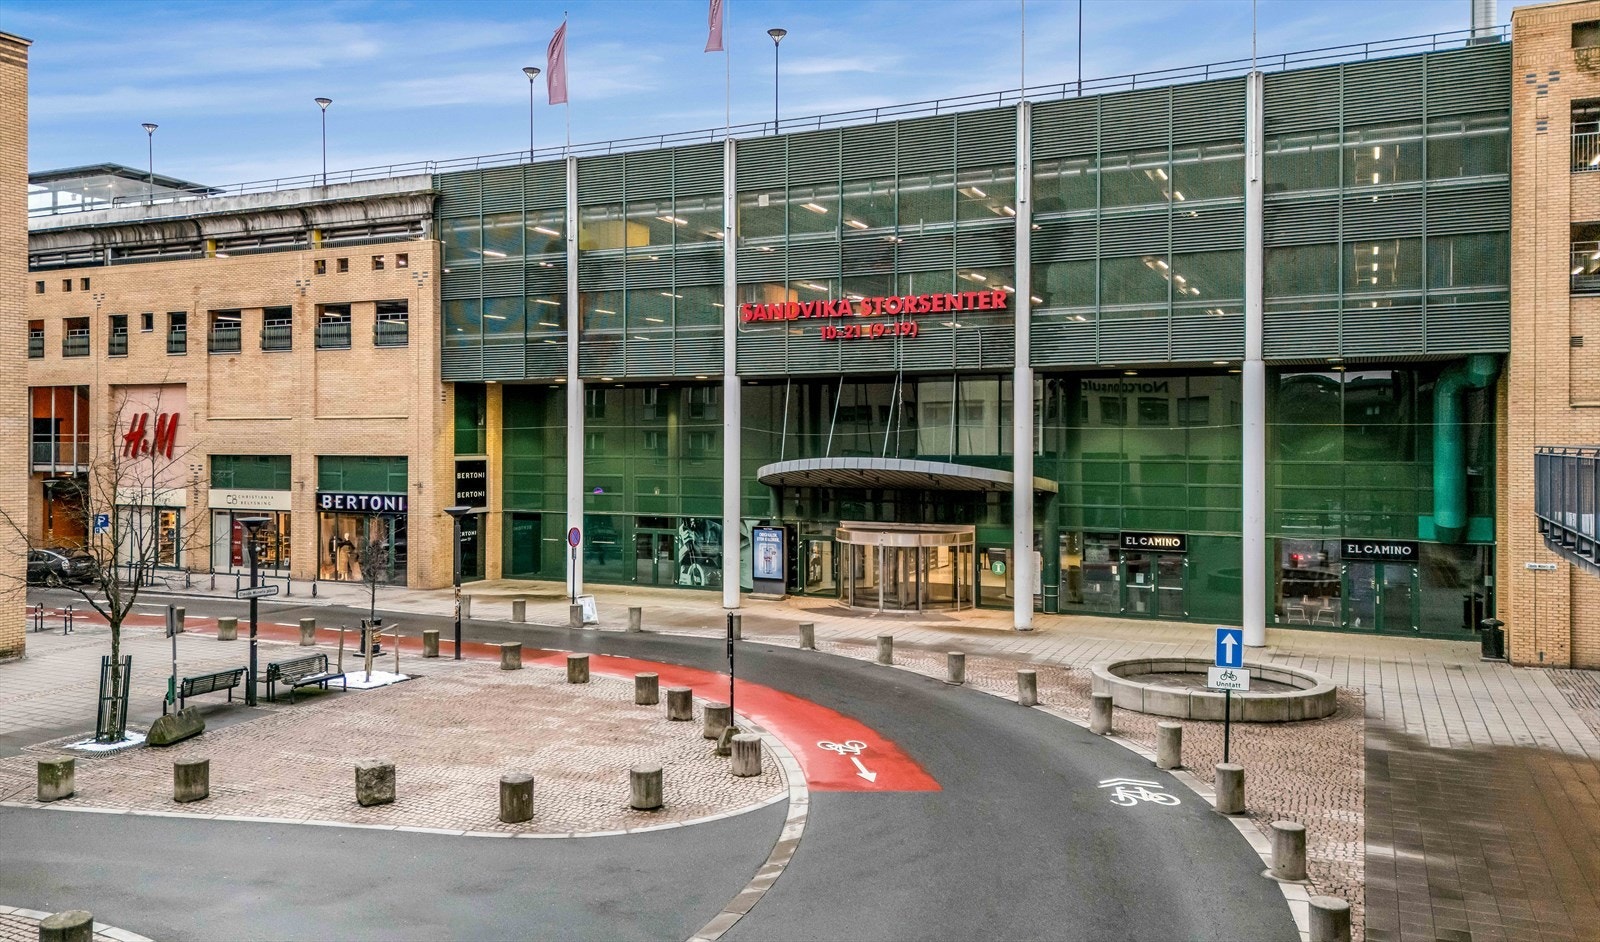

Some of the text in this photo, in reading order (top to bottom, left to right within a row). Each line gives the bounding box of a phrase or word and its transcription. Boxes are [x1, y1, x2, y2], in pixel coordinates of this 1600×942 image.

[742, 289, 1008, 323] SANDVIKA STORSENTER
[821, 321, 919, 341] 10-21 (9-19)
[122, 412, 181, 461] H&M
[322, 494, 403, 511] BERTONI
[1125, 536, 1181, 547] EL CAMINO
[1347, 544, 1412, 555] EL CAMINO
